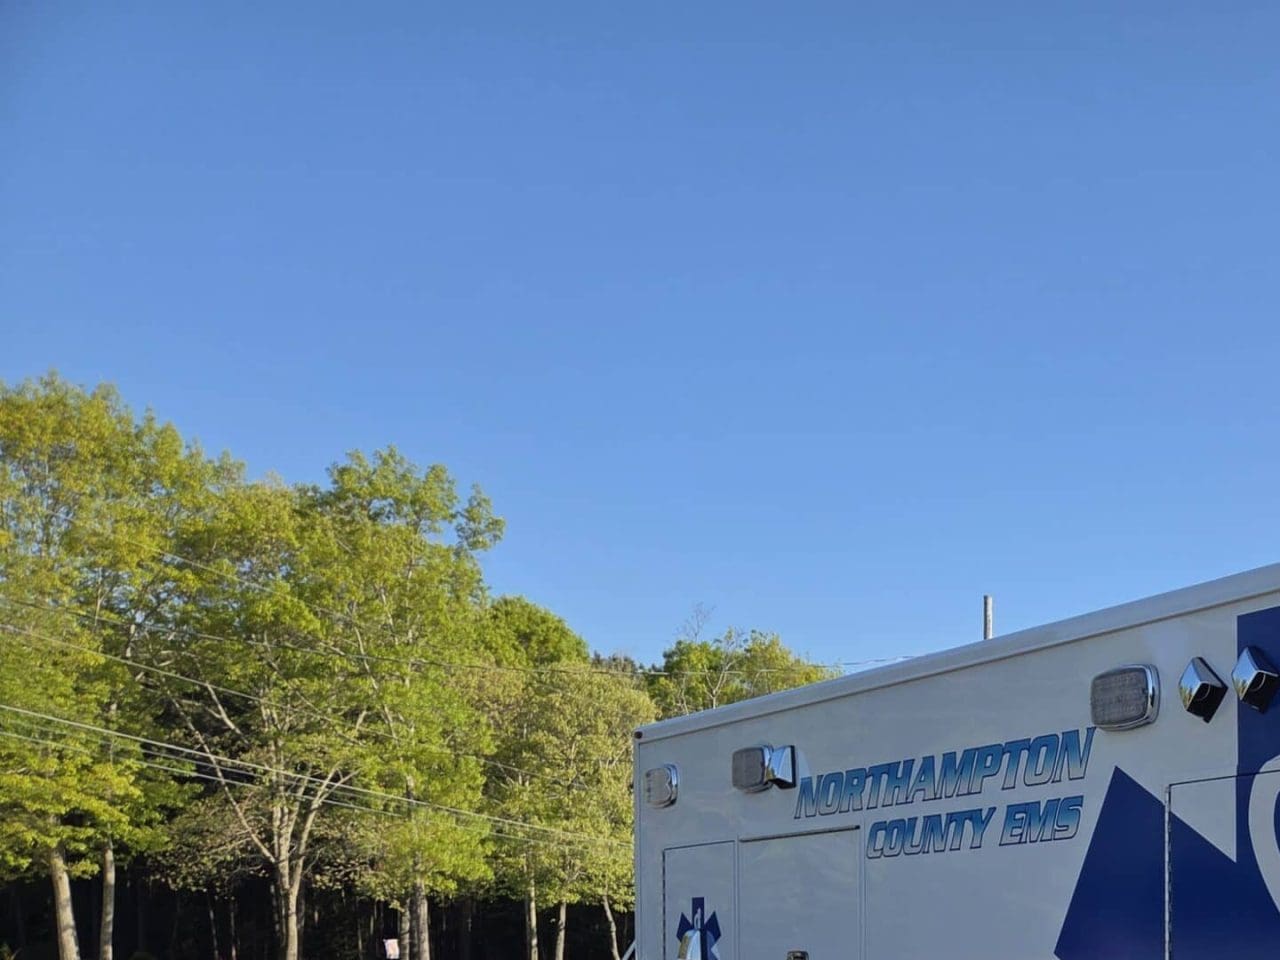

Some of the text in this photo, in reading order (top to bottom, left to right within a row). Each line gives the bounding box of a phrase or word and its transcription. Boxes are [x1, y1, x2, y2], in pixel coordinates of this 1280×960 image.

[794, 726, 1097, 819] NORTHAMPTON
[866, 795, 1084, 859] COUNTY EMS
